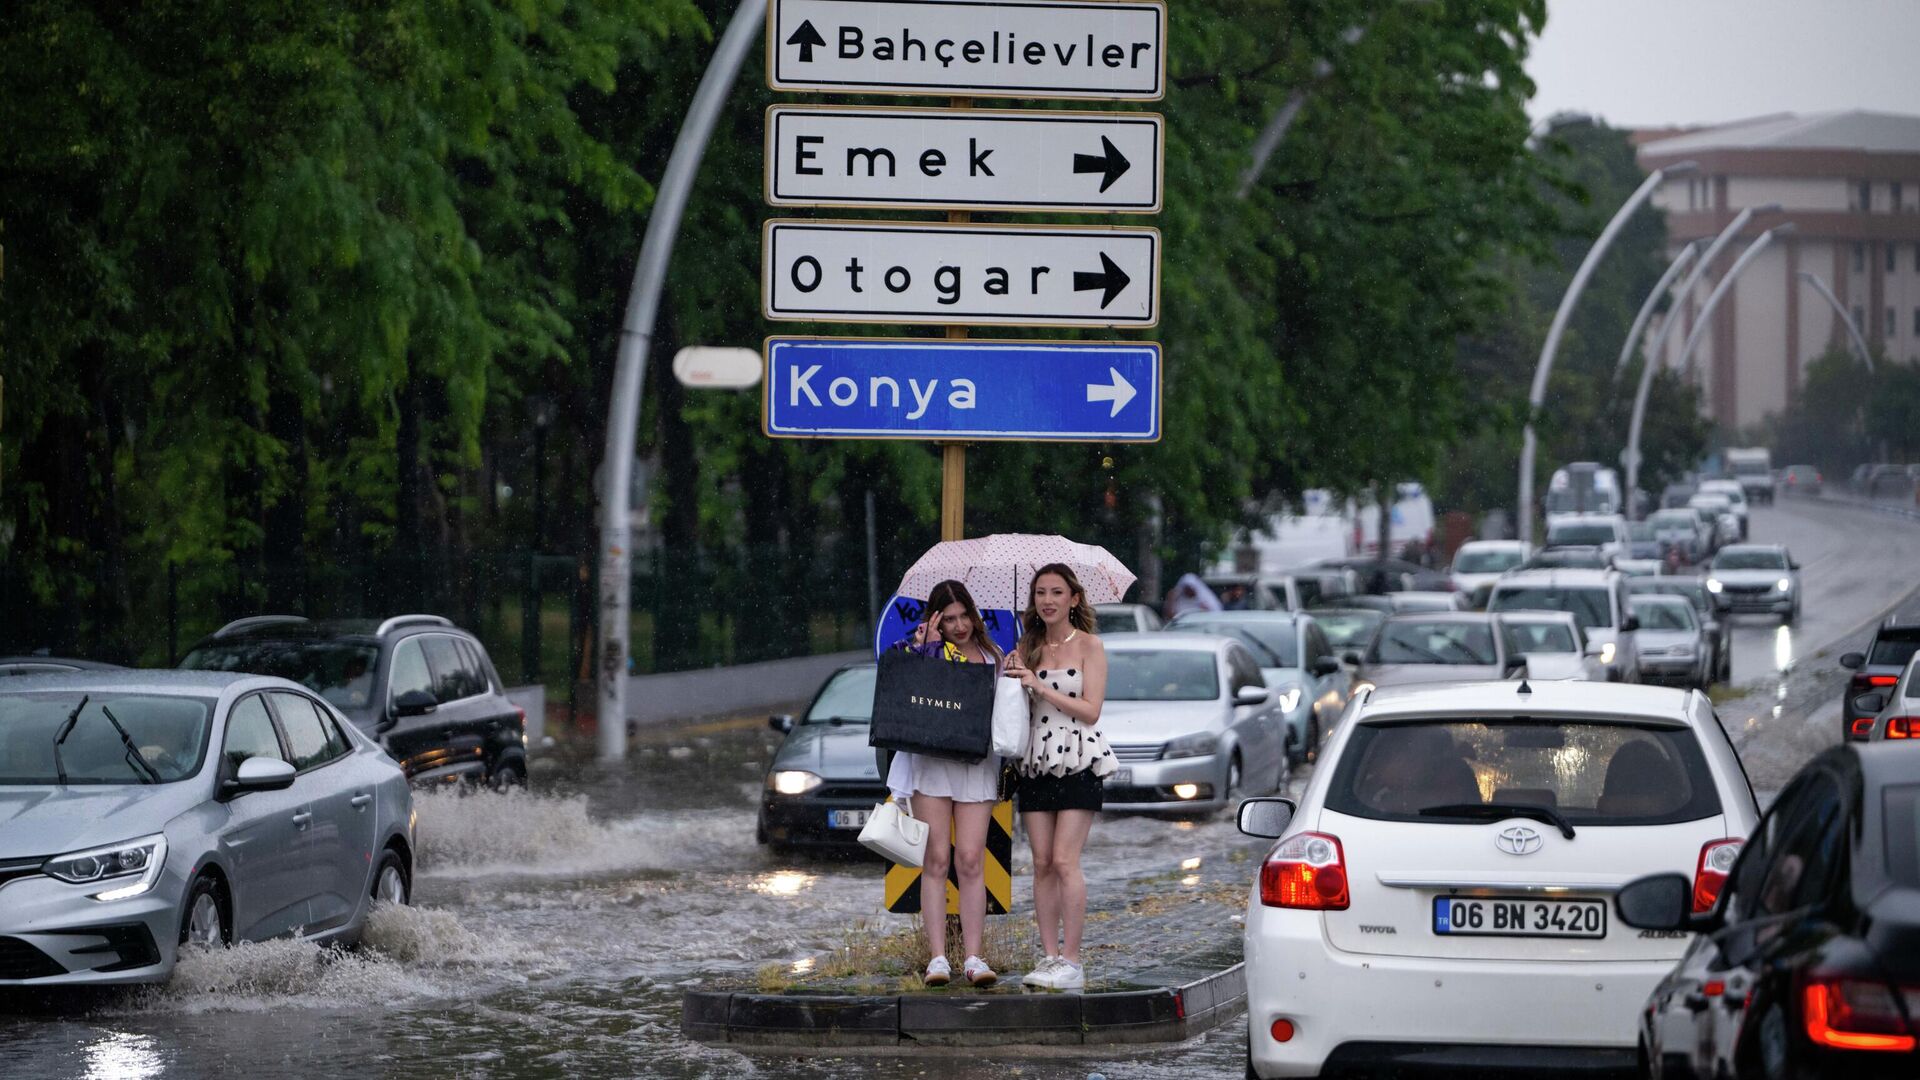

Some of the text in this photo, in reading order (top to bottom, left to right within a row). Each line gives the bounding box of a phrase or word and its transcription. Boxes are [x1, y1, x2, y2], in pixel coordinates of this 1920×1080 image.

[837, 25, 1152, 69] Bahçelievler
[795, 135, 996, 177] Emek
[790, 255, 1051, 305] Otogar
[790, 365, 976, 420] Konya
[911, 695, 962, 710] BEYMEN
[1358, 924, 1397, 935] TOYOTA
[1451, 902, 1600, 932] 06 BN 3420
